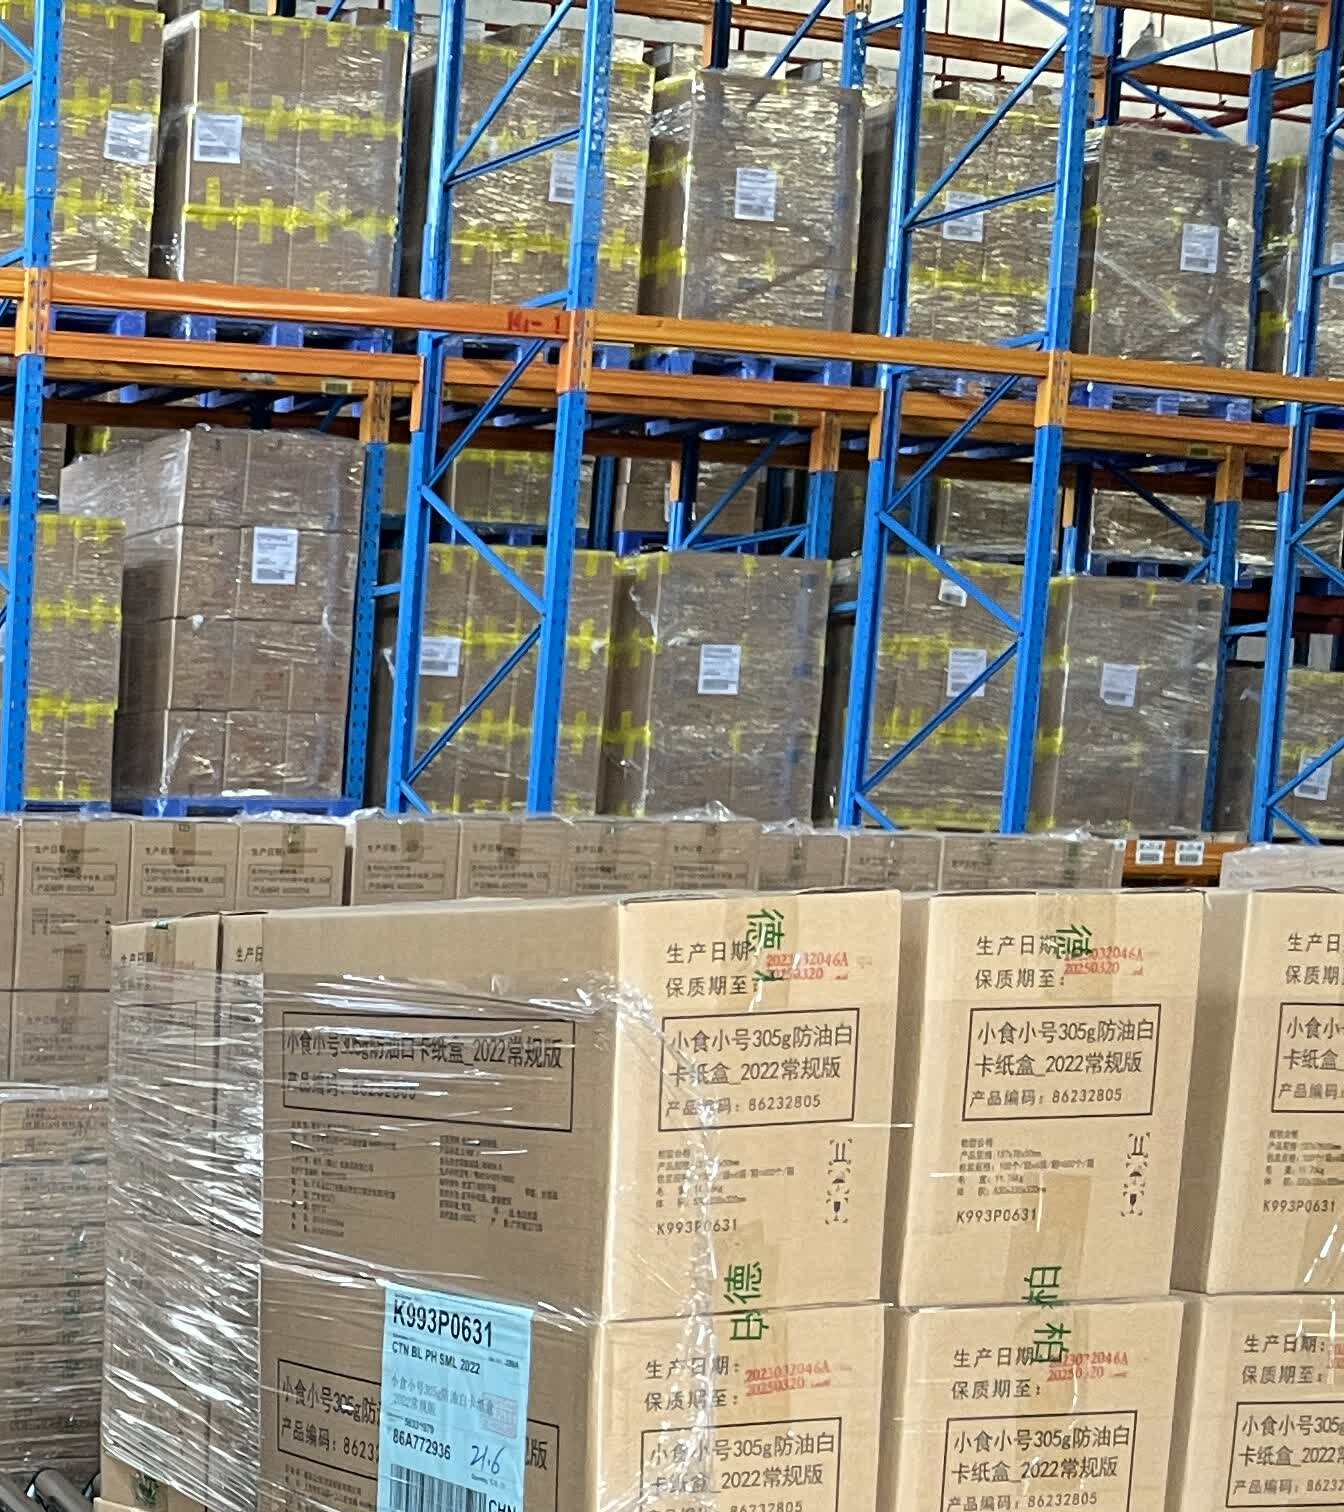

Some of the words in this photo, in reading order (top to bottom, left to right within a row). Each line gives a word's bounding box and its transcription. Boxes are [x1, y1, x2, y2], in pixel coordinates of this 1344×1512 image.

[975, 969, 1065, 990] 保质期至：
[672, 1024, 852, 1052] 小食小号305g防油白
[978, 1019, 1154, 1045] 小食小号305g防油白
[976, 1051, 1143, 1078] 卡纸盒_2022常规版
[969, 1088, 1122, 1108] 产品编码：86232805
[957, 1208, 1036, 1223] K993P0631
[1263, 1199, 1336, 1213] K993P0631
[393, 1299, 492, 1348] K993P0631
[391, 1341, 409, 1355] CTN
[425, 1349, 437, 1362] PH
[1242, 1365, 1323, 1385] 保质期至：
[951, 1379, 1041, 1400] 保质期至：
[393, 1428, 451, 1460] 86A772936
[954, 1426, 1130, 1454] 小食小号305g防油白
[952, 1457, 1118, 1484] 卡纸盒_2022常规版
